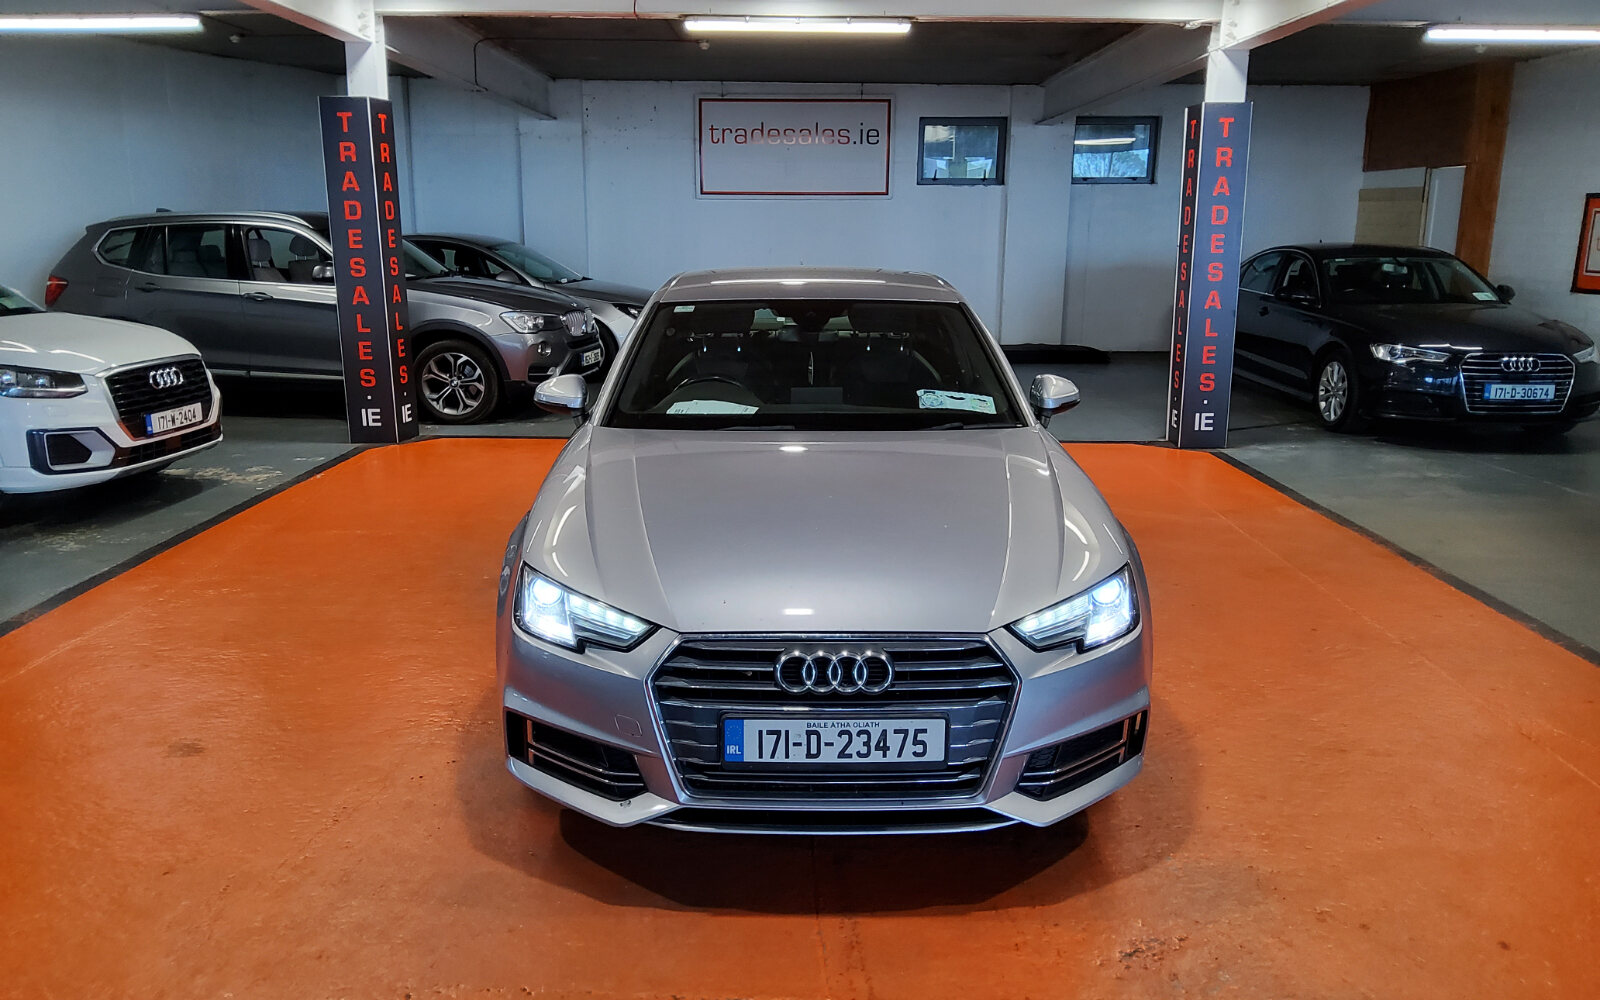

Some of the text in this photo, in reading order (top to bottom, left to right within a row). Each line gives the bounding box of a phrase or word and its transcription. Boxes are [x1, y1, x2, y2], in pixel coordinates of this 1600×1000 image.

[709, 121, 880, 145] tradesales.ie
[1494, 388, 1549, 398] 171-D-30674
[157, 407, 197, 430] 171-W-2404
[726, 745, 741, 755] IRL
[757, 728, 928, 760] 171-D-23475
